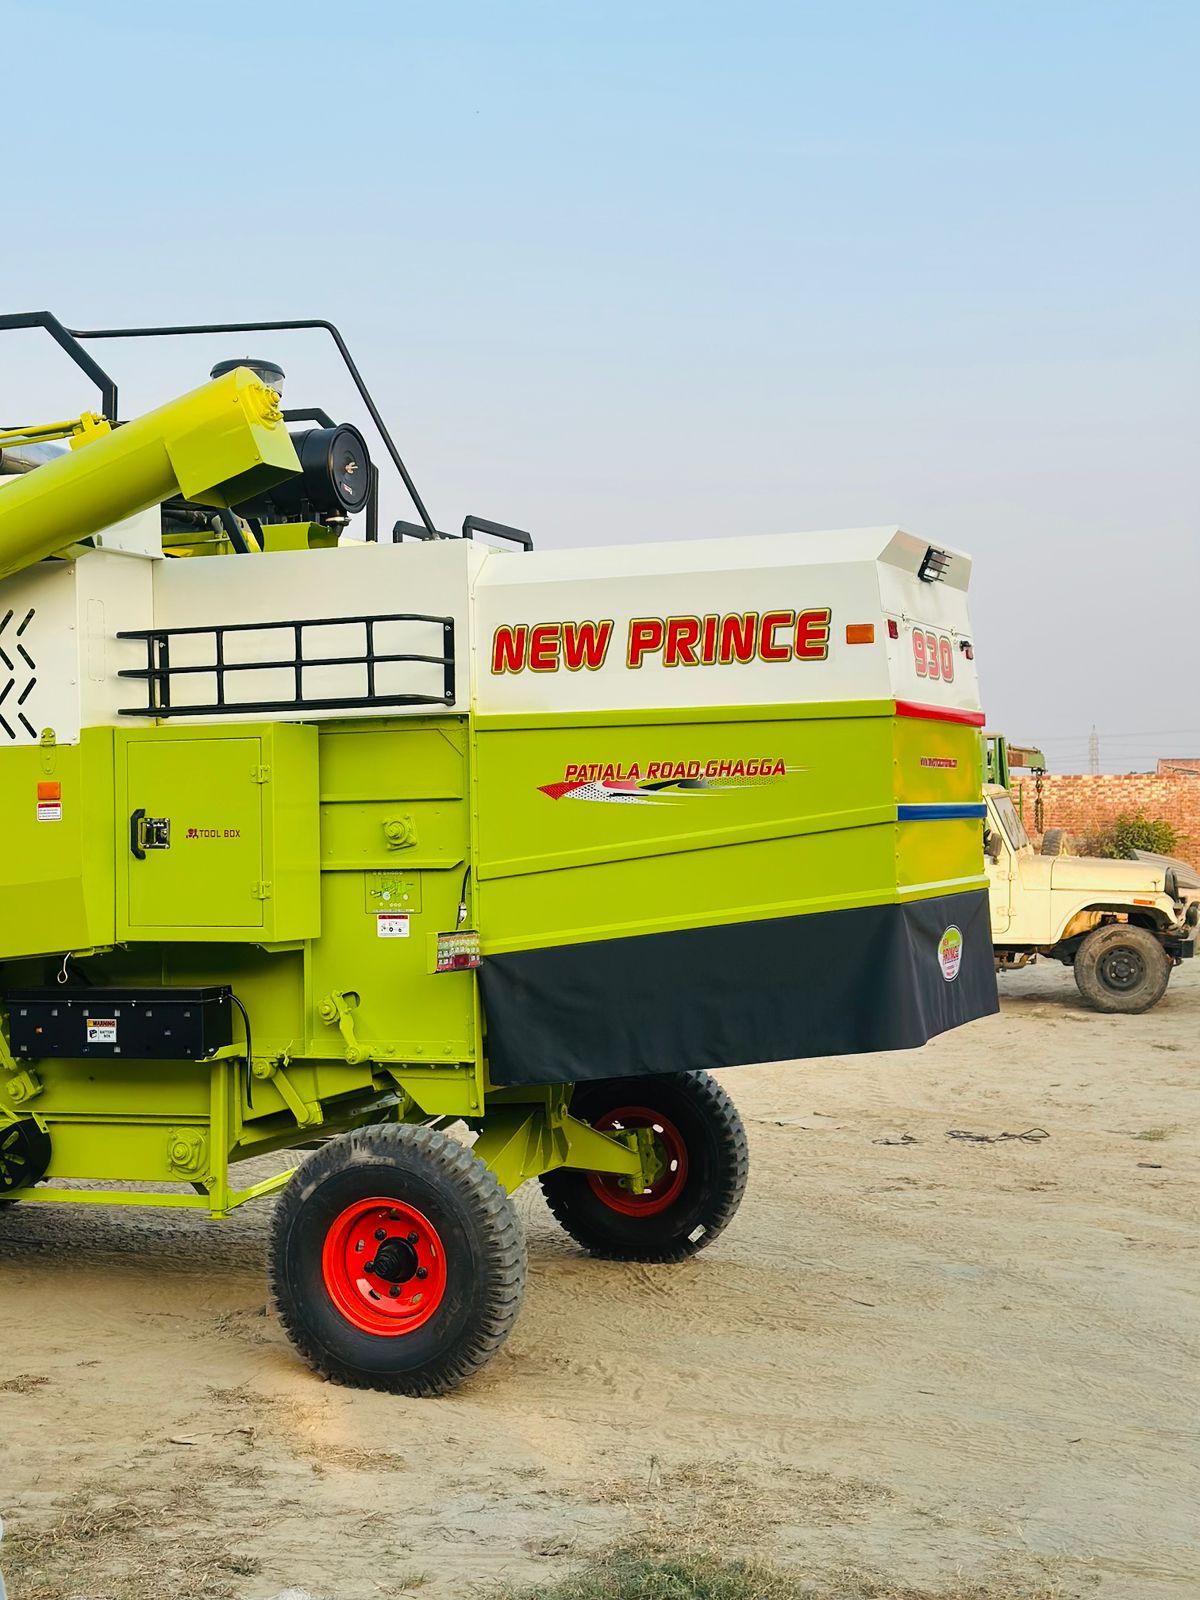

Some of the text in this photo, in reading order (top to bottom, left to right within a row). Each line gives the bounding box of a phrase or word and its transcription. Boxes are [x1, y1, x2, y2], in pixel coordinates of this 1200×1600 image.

[491, 607, 831, 675] NEW PRINCE
[912, 627, 954, 683] 930
[564, 763, 640, 782] PATIALA
[199, 829, 241, 838] TOOL BOX
